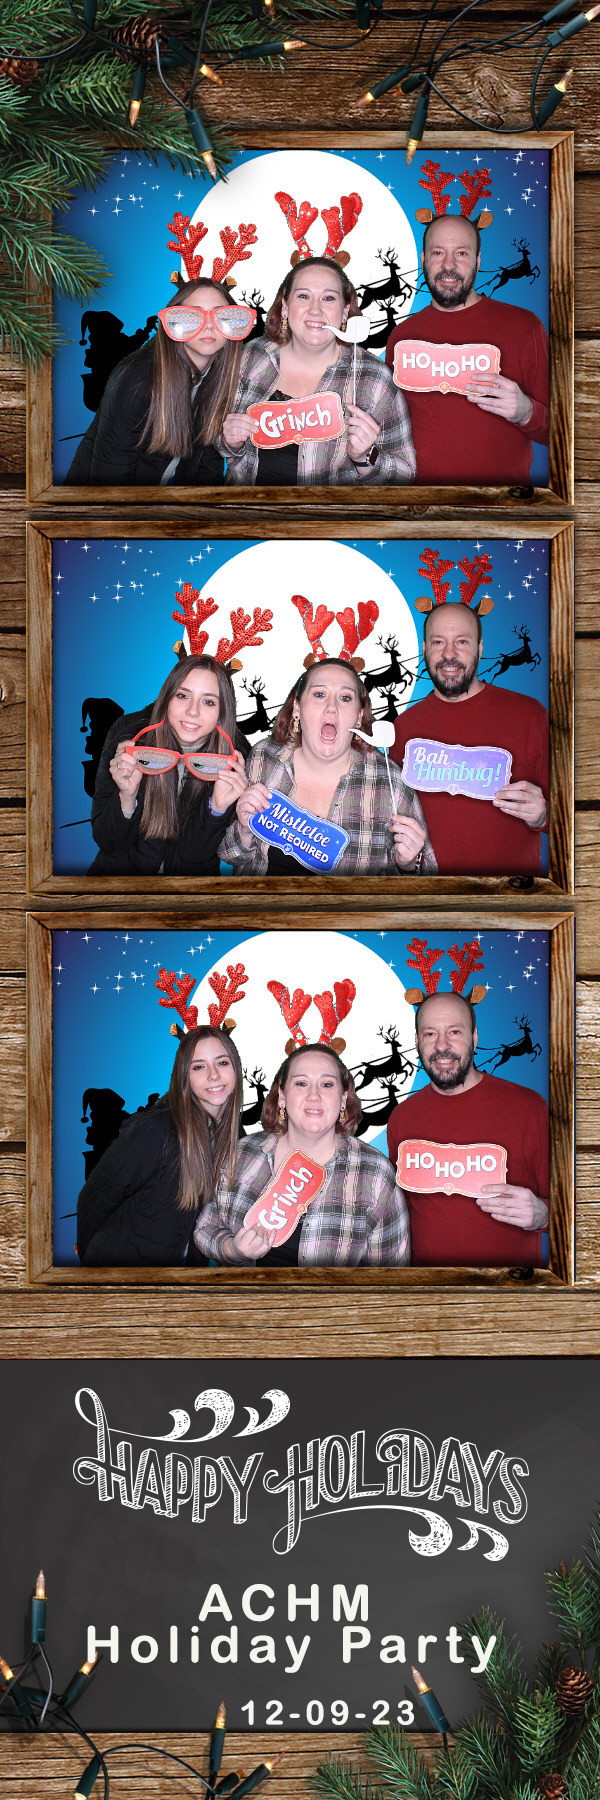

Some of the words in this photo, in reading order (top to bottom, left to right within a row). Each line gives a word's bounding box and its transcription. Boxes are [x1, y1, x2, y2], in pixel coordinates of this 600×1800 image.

[412, 746, 450, 766] Bah
[412, 760, 502, 788] Humbug!
[257, 814, 280, 834] NOT
[279, 827, 330, 864] REQUIRED
[269, 802, 331, 848] Mistletoe
